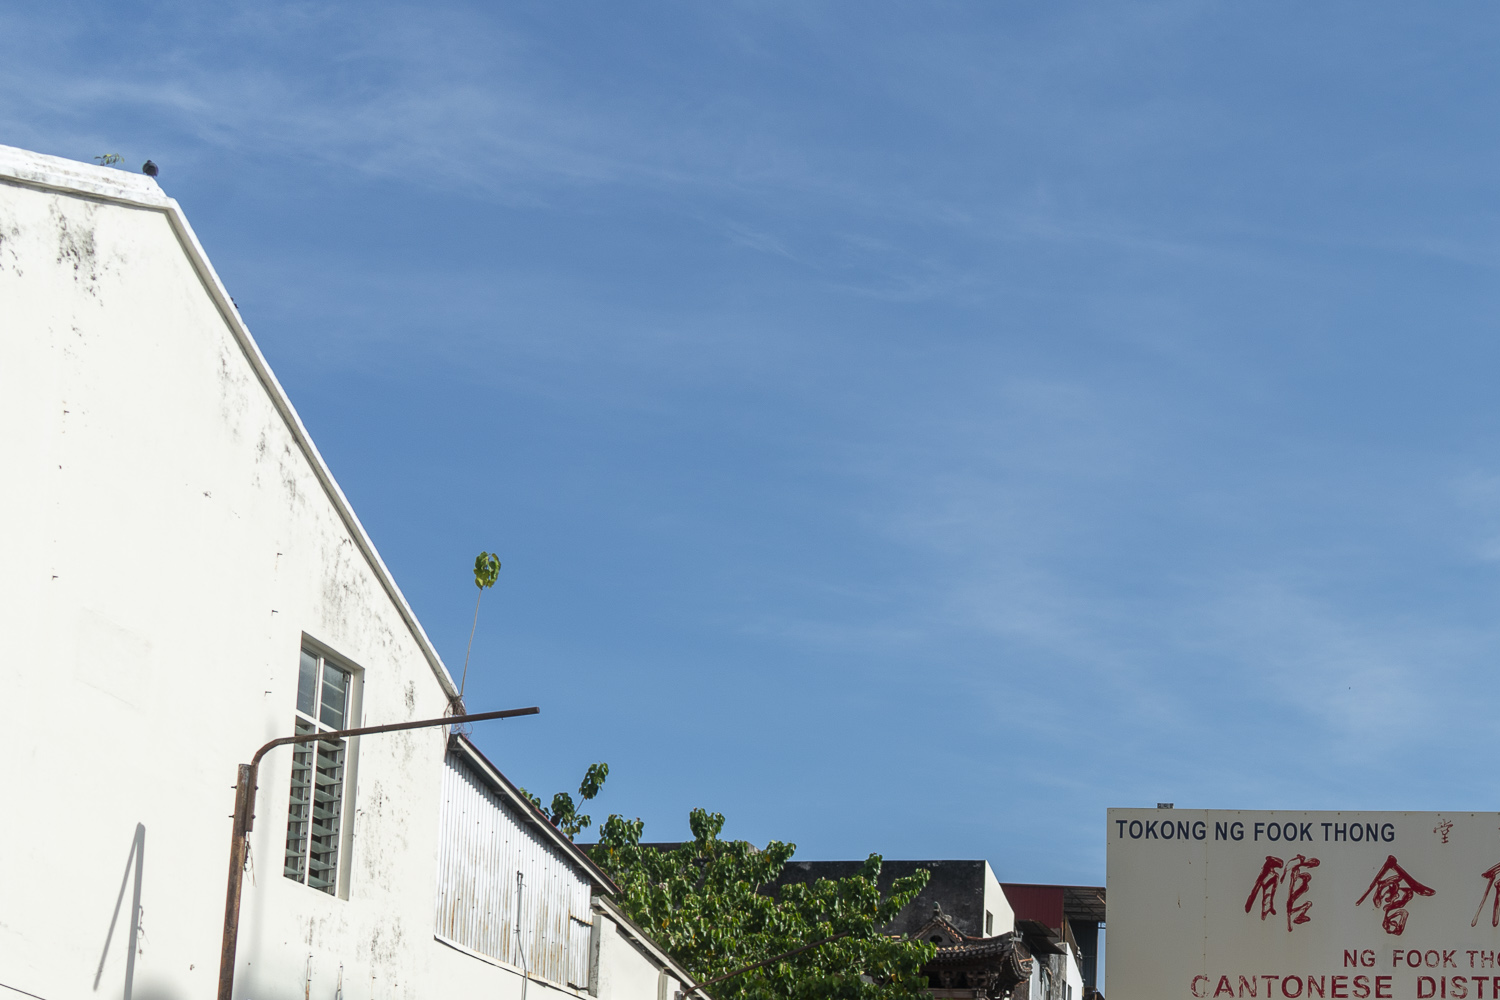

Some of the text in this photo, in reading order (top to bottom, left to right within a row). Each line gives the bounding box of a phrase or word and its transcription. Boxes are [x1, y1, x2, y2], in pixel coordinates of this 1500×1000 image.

[1115, 819, 1395, 843] TOKONG NG FOOK THONG
[1343, 949, 1376, 969] NG
[1392, 949, 1457, 969] FOOK
[1190, 974, 1394, 1000] CANTONESE
